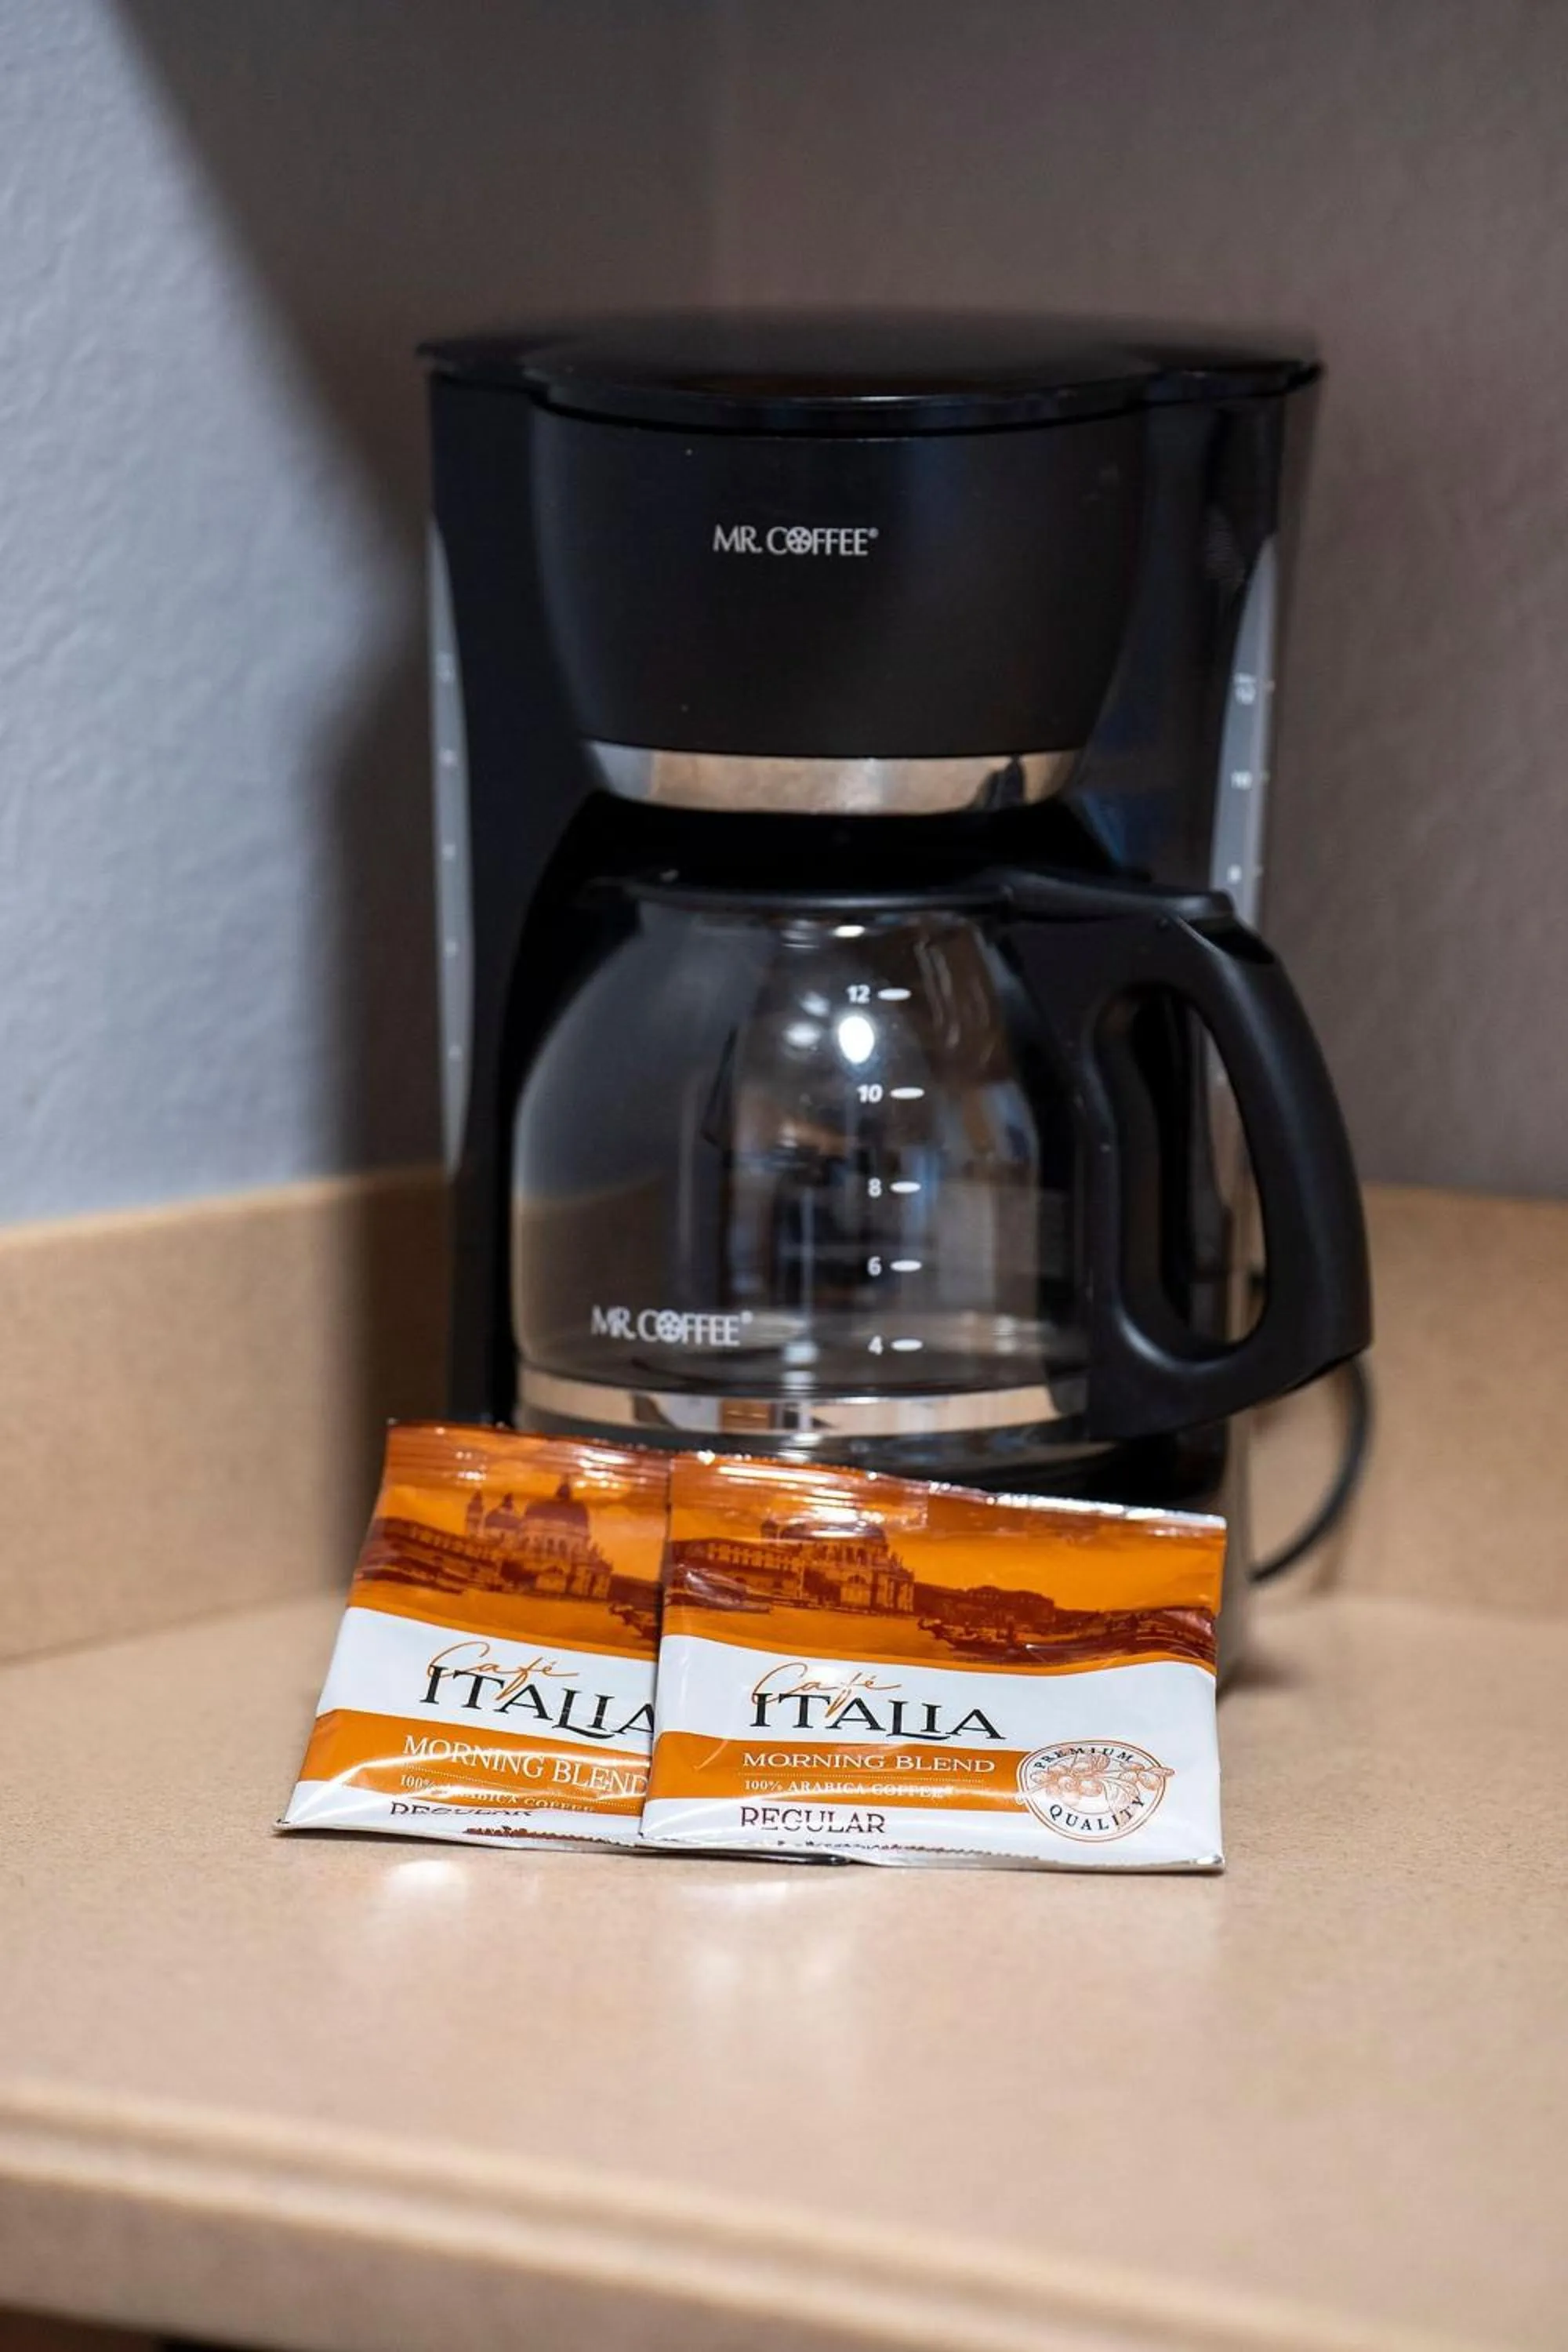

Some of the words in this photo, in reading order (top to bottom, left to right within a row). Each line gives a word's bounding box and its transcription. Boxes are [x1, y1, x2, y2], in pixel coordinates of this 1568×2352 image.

[712, 524, 763, 554] MR.
[765, 526, 869, 557] COFFEE
[847, 984, 871, 1004] 12
[857, 1083, 884, 1103] 10
[867, 1178, 882, 1198] 8
[867, 1256, 882, 1276] 6
[867, 1335, 884, 1356] 4
[426, 1641, 579, 1700] Café
[419, 1664, 655, 1739] ITALIA
[751, 1662, 901, 1719] Café
[750, 1693, 1007, 1741] ITALIA
[403, 1733, 545, 1778] MORNING
[552, 1759, 648, 1796] BLEND
[742, 1751, 885, 1770] MORNING
[895, 1755, 996, 1773] BLEND
[1033, 1747, 1134, 1769] PREMIUM
[744, 1780, 782, 1792] 100%
[788, 1780, 864, 1795] ARABICA
[740, 1806, 886, 1835] REGULAR
[1049, 1795, 1145, 1831] QUALITY
